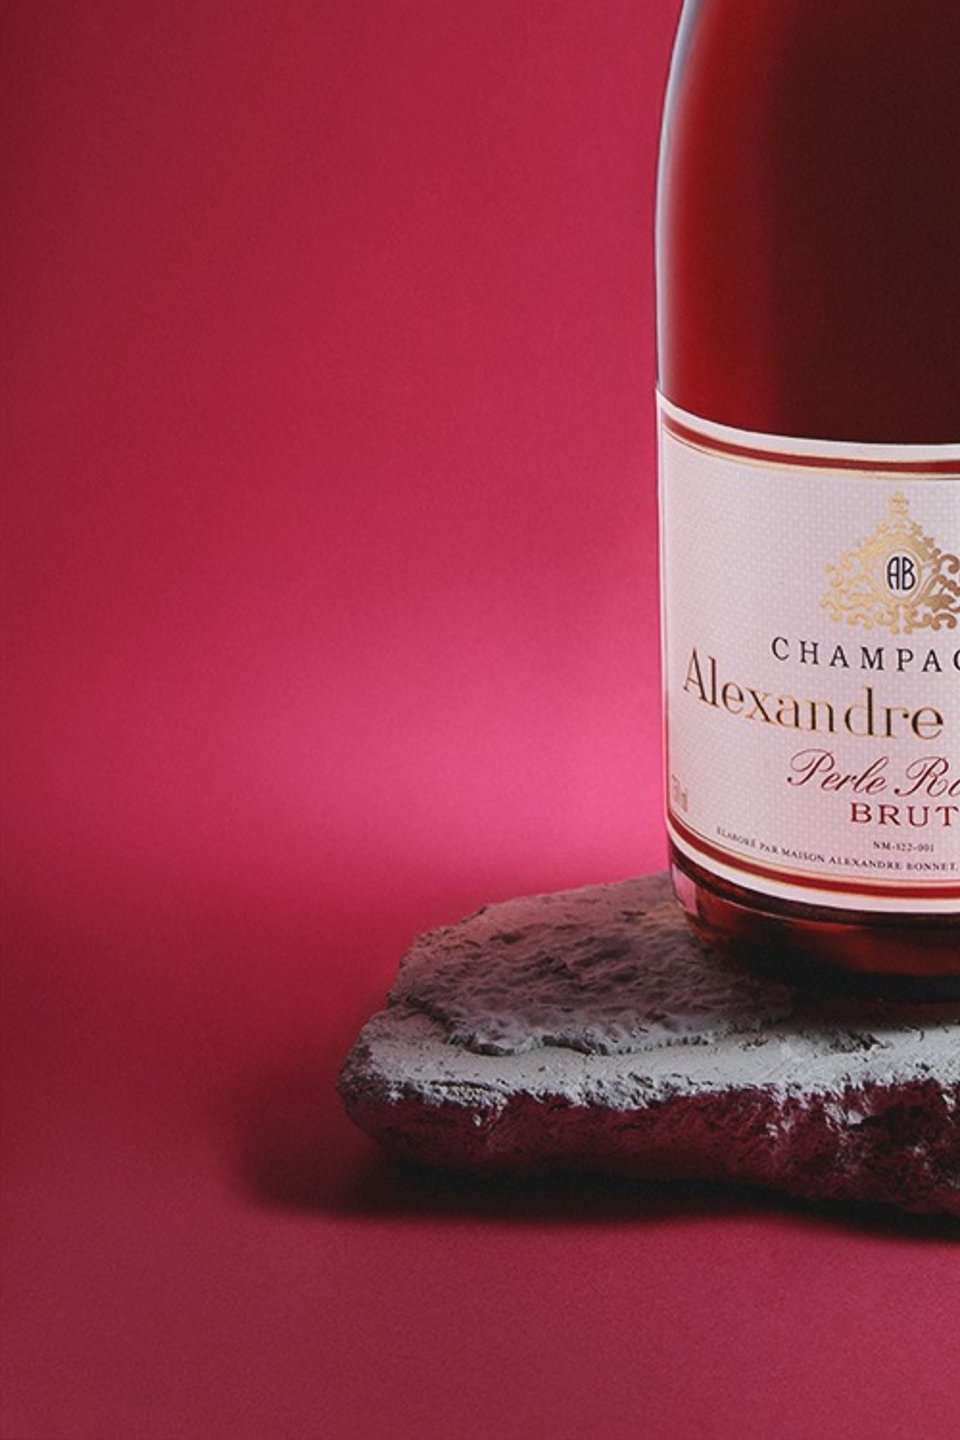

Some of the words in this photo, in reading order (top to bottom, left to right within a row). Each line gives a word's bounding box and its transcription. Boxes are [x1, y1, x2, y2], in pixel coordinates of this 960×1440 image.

[887, 556, 916, 591] AB
[683, 646, 944, 740] Alexandre
[786, 748, 889, 796] Perle
[850, 802, 960, 828] BRUT
[759, 842, 778, 855] PAR
[781, 848, 825, 864] MAISON
[829, 856, 902, 871] ALEXANDRE
[873, 841, 935, 853] NM-122-001
